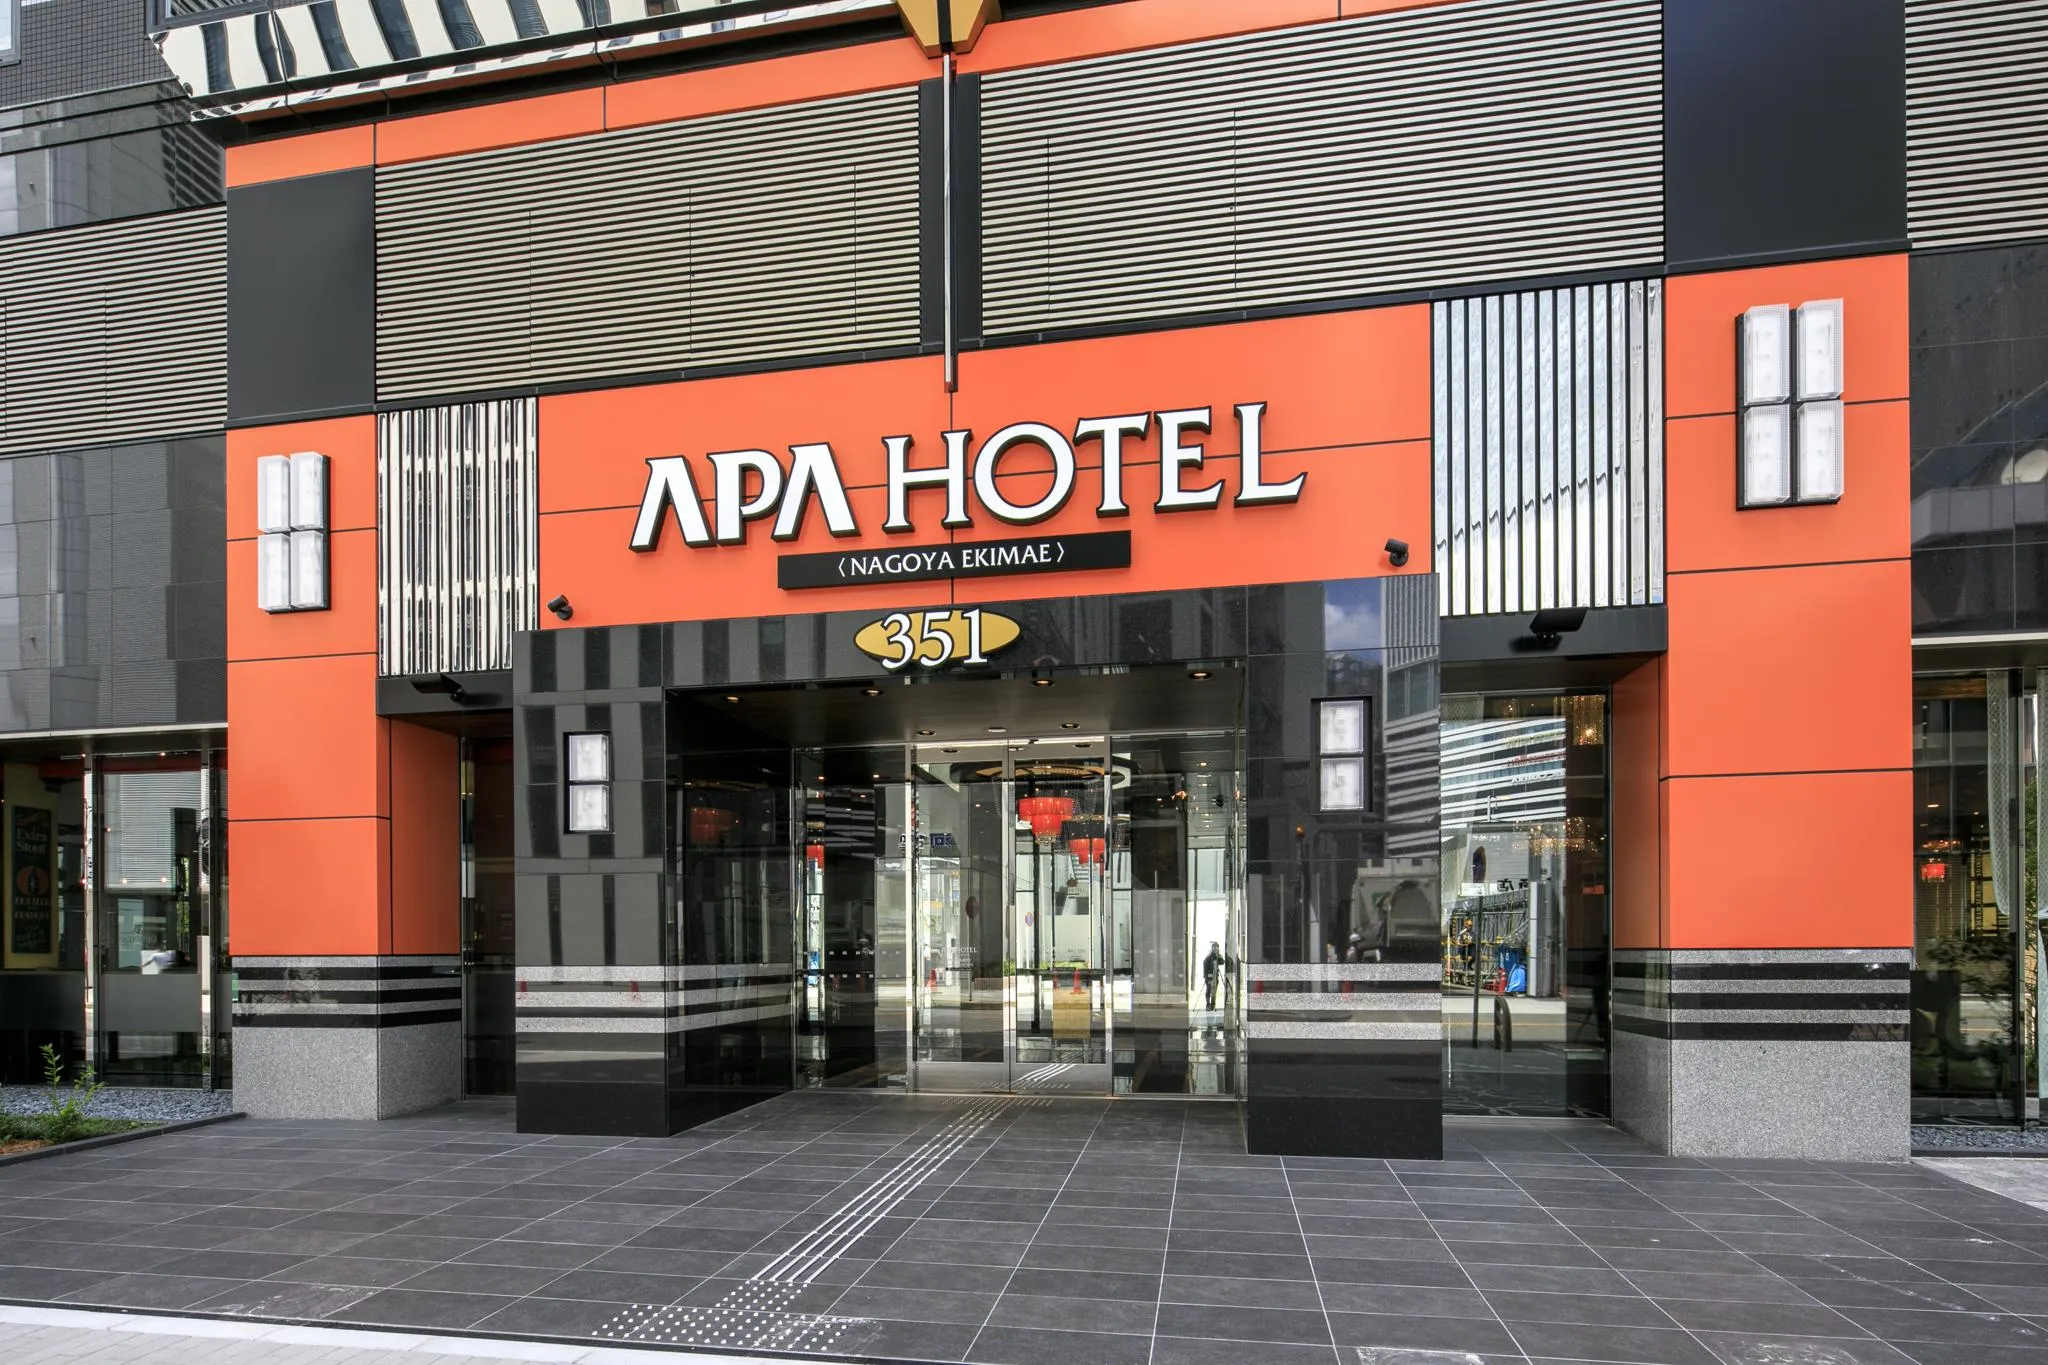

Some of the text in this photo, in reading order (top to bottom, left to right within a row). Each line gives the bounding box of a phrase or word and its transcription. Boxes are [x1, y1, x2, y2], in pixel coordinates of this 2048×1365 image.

[629, 401, 1308, 553] APA HOTEL
[880, 608, 989, 670] 351
